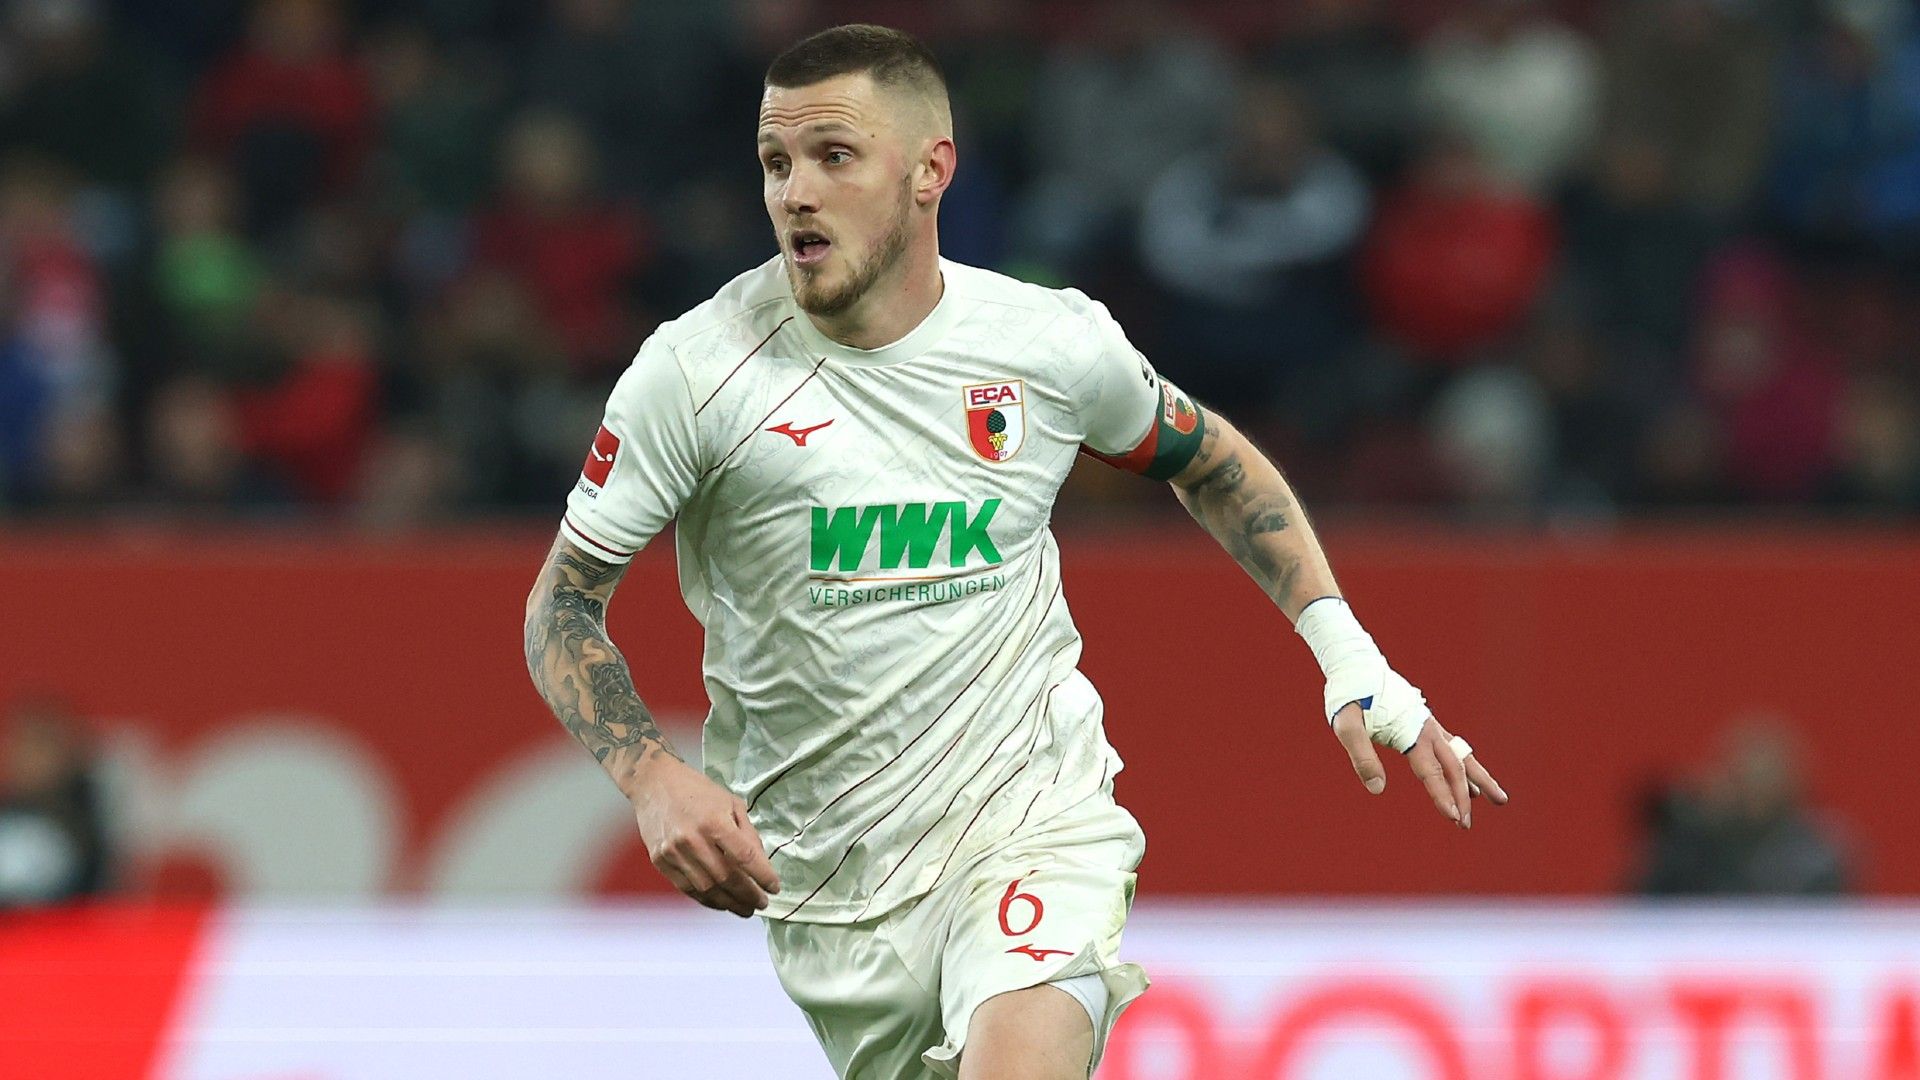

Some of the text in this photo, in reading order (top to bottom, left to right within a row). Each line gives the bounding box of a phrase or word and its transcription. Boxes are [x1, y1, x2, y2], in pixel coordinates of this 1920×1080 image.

[970, 385, 1017, 405] FCA
[810, 498, 1004, 572] WWK
[809, 574, 1006, 606] VERSICHERUNGEN
[998, 869, 1043, 936] 6
